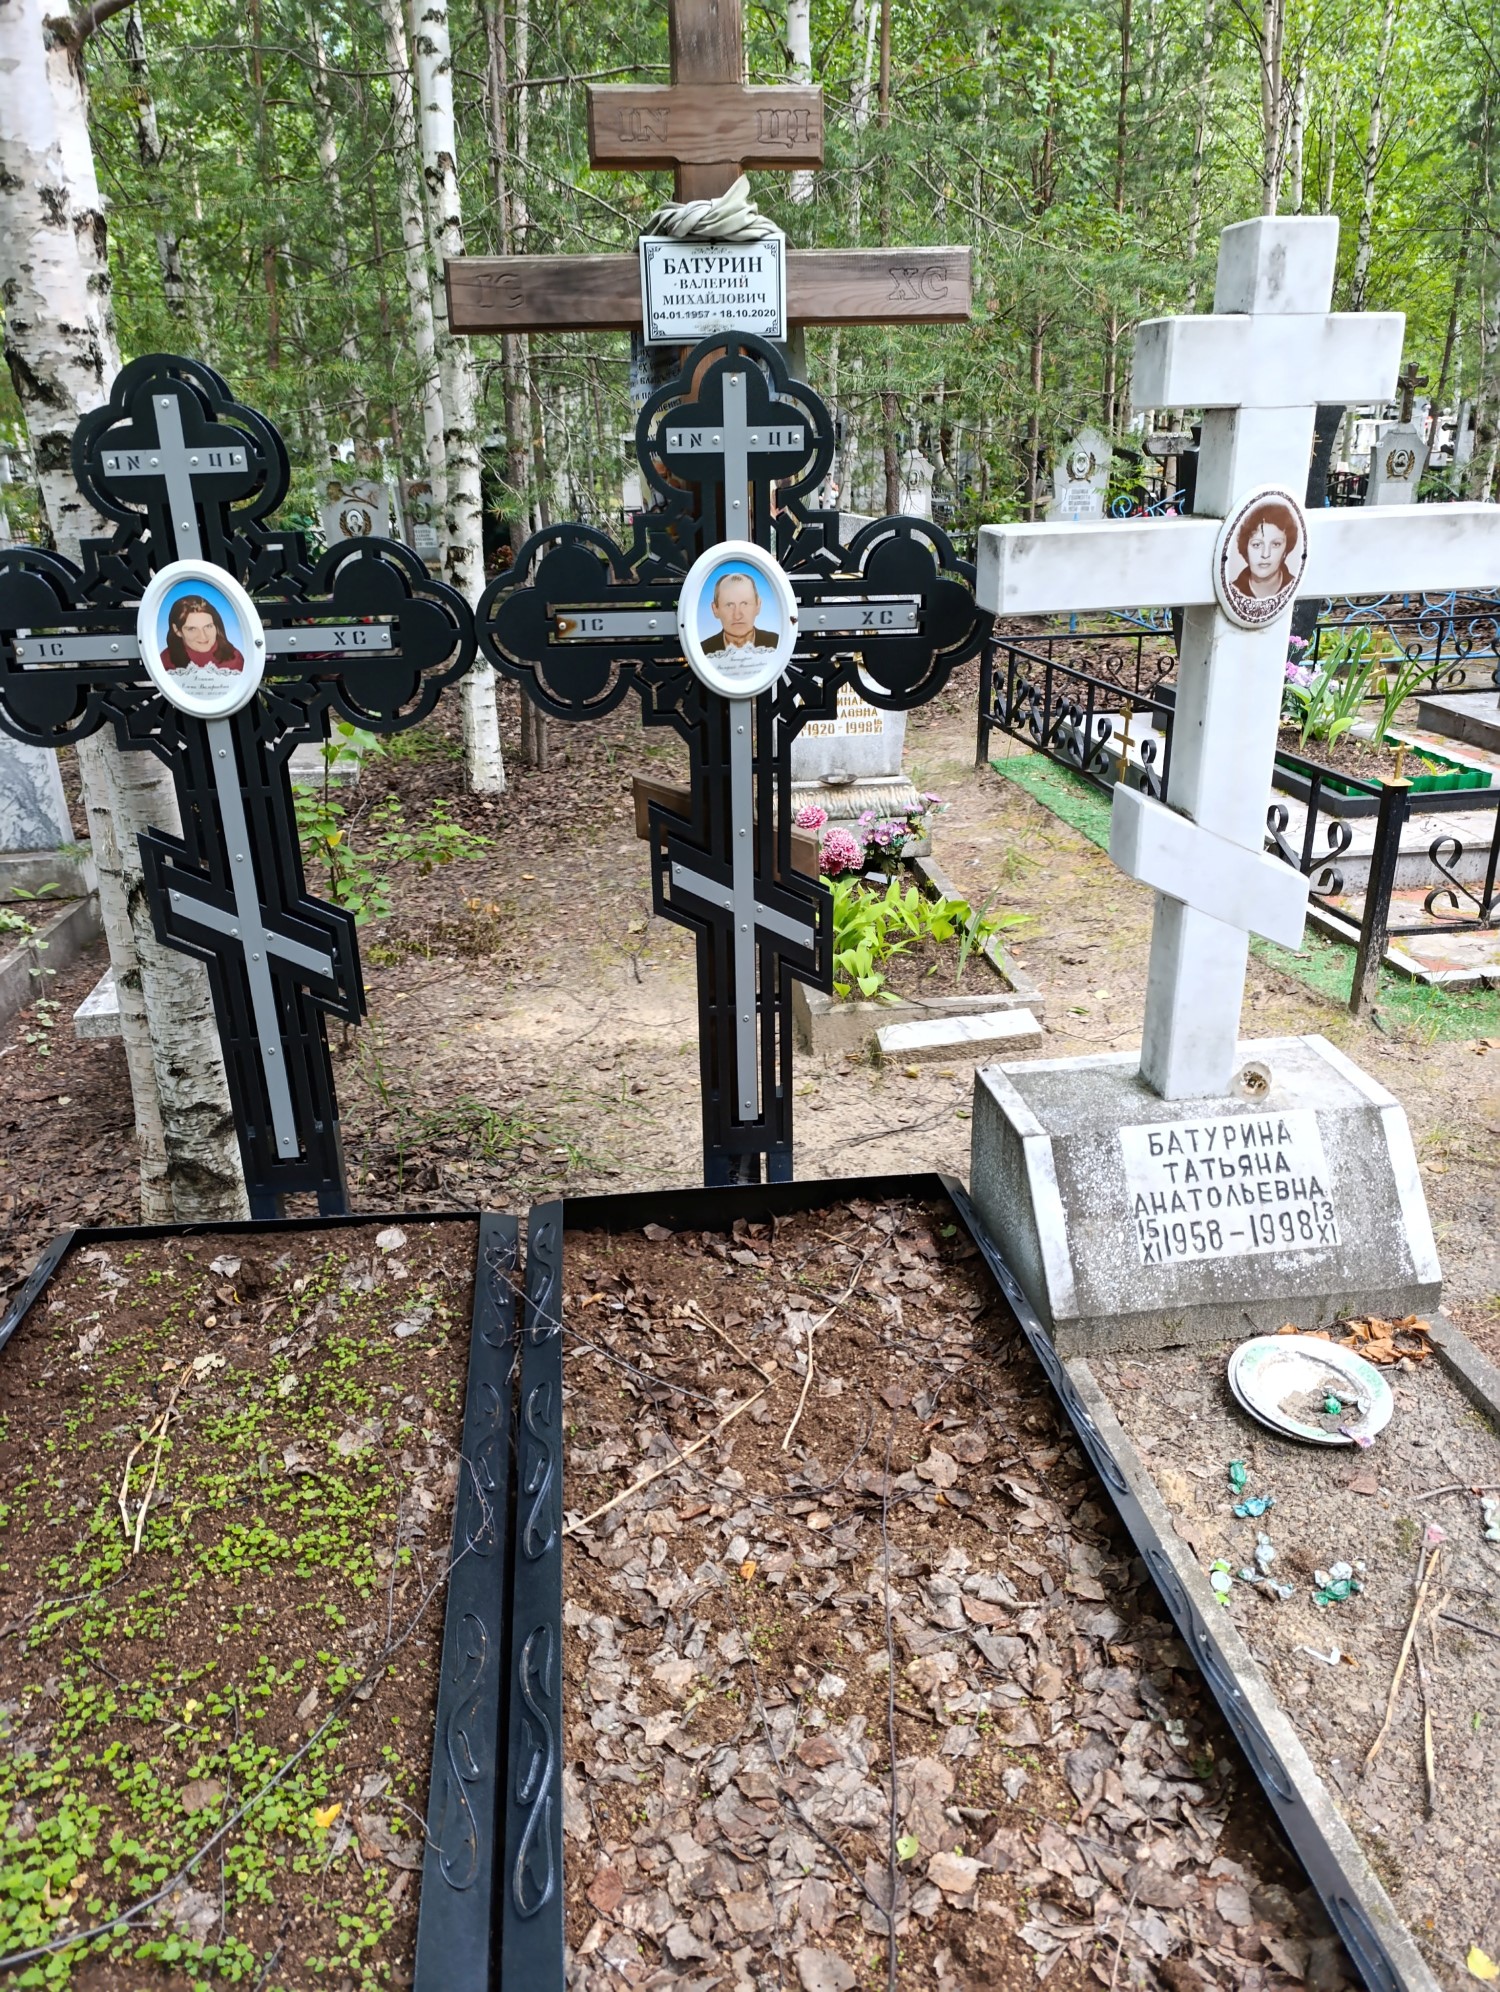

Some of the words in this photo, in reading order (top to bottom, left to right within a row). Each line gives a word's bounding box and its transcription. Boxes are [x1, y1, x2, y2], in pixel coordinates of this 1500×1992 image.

[663, 256, 763, 275] БАТУРИН
[679, 275, 749, 290] ВАЛЕРИЙ
[663, 291, 766, 306] МИХАЙЛОВИЧ
[653, 310, 711, 320] 04.01.1957
[719, 308, 777, 318] 18.10.2020
[846, 720, 872, 734] 1998
[1147, 1118, 1293, 1157] БАТУРИНА
[1162, 1150, 1292, 1185] ТАТЬЯНА
[1133, 1174, 1327, 1220] АНАТОЛЬЕВНА
[1163, 1218, 1224, 1257] 1958
[1249, 1209, 1314, 1248] 1998
